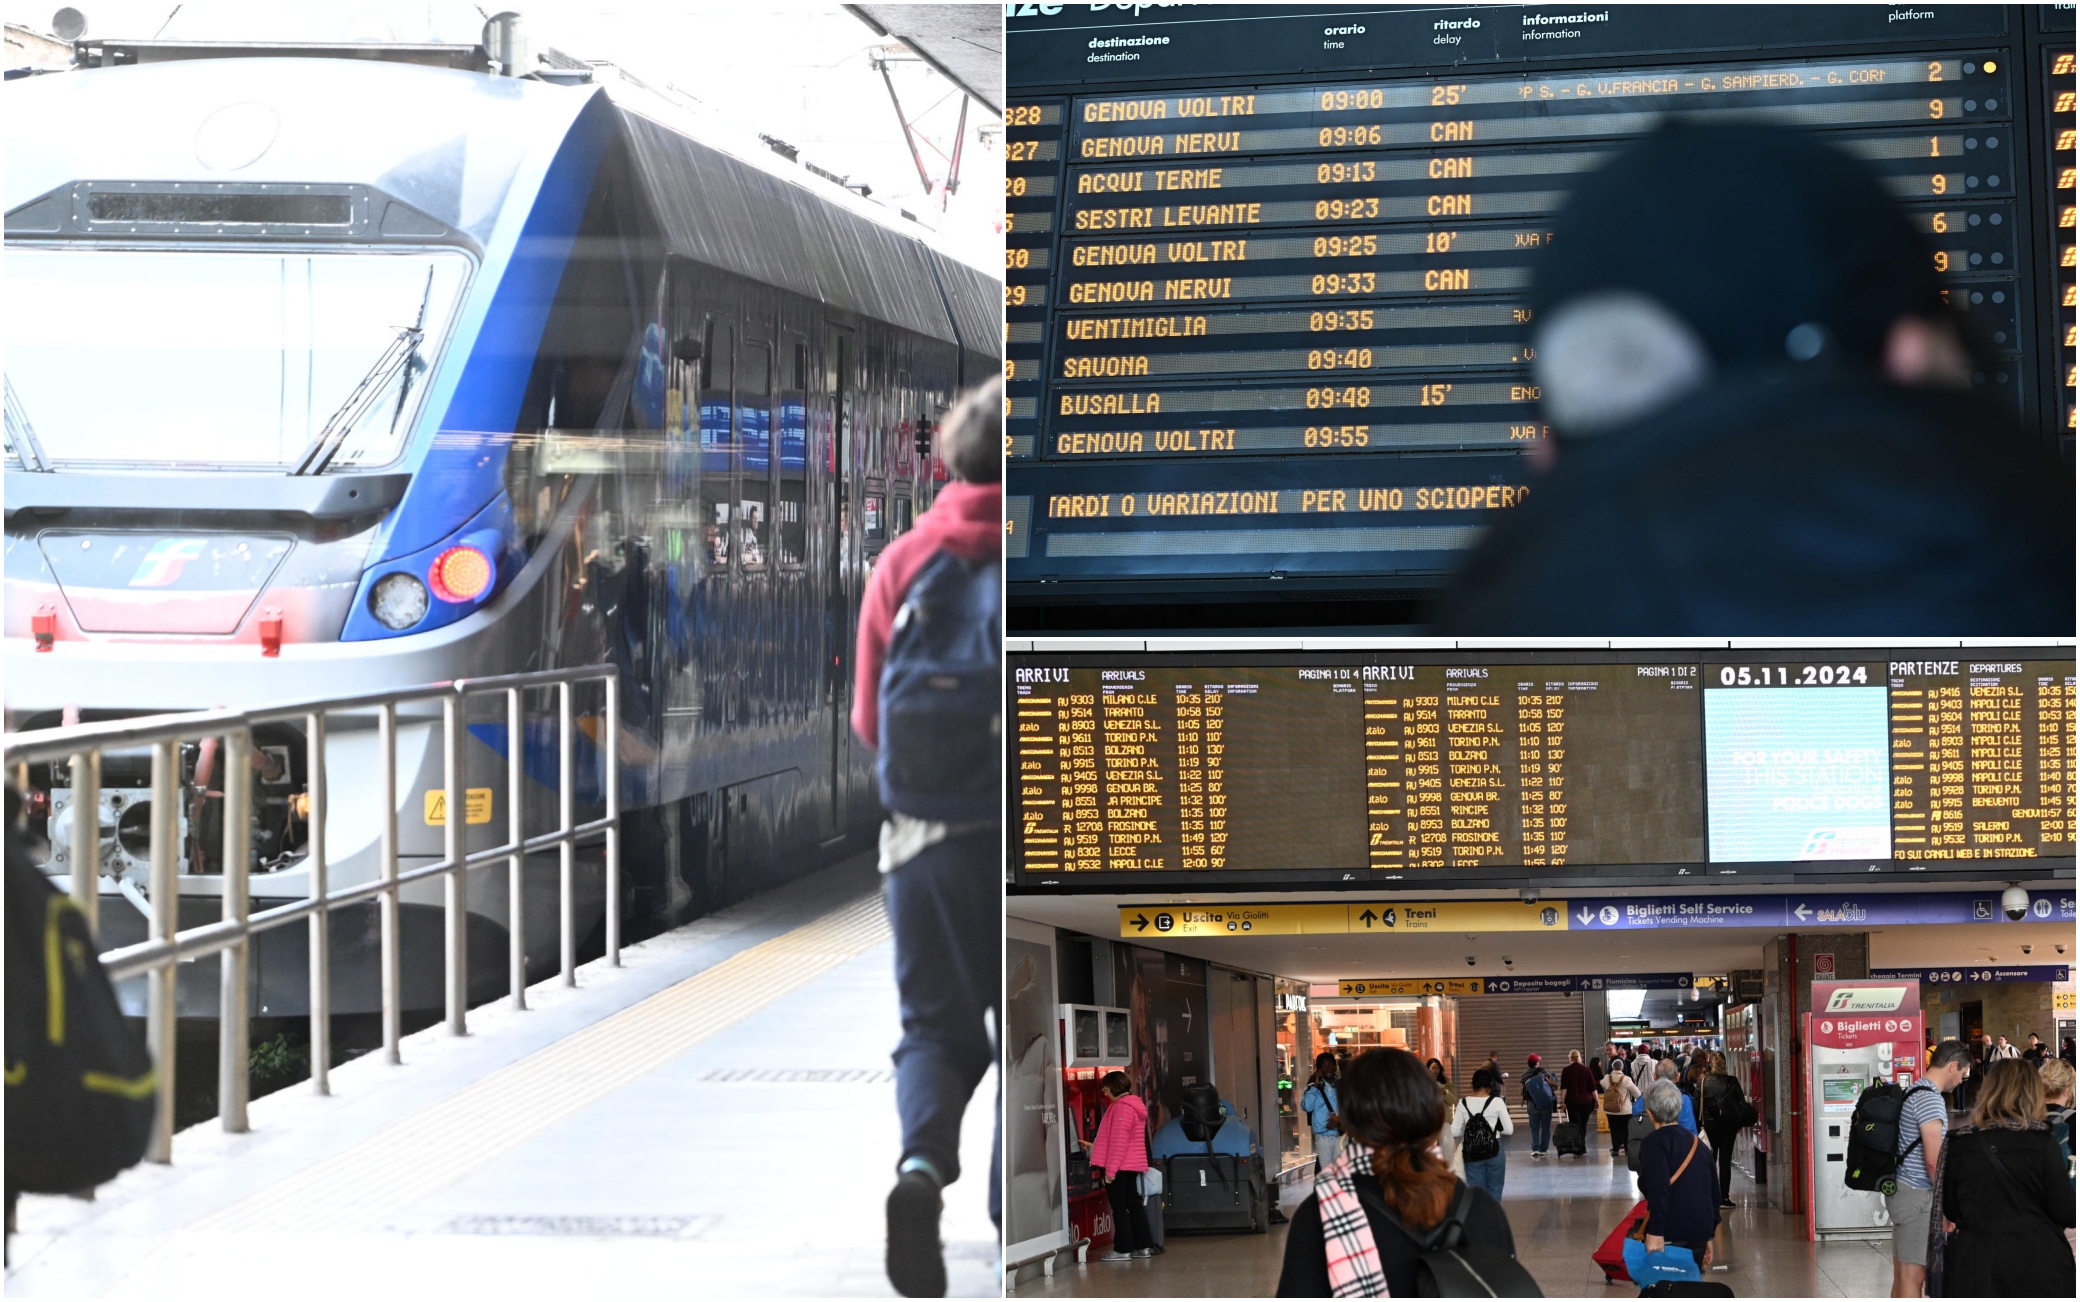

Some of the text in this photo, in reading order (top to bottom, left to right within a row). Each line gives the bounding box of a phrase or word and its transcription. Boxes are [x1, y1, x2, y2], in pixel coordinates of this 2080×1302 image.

[1522, 11, 1609, 26] informazioni
[1888, 8, 1935, 23] platform
[1324, 24, 1366, 36] orario
[1434, 18, 1481, 30] ritardo
[1088, 34, 1171, 47] destinazione
[1433, 34, 1461, 46] delay
[1522, 29, 1581, 41] information
[1323, 40, 1345, 50] time
[1087, 51, 1140, 63] destination
[1085, 100, 1166, 122] GENOVA
[1178, 95, 1255, 117] VOLTRI
[1321, 89, 1384, 111] 09:00
[1431, 85, 1466, 106] 25'
[1576, 84, 1592, 96] G.
[1700, 77, 1716, 91] G.
[1721, 73, 1804, 90] SAMPIERD.
[1827, 71, 1844, 84] G.
[1928, 61, 1942, 82] 2
[1082, 99, 1944, 158] GENOVA NERVI 09:06 CAN 9
[1078, 137, 1940, 193] ACQUI TERME 09:13 CAN 1
[1076, 174, 1947, 229] SESTRI LEVANTE 09:23 CAN 9
[1073, 212, 1948, 266] GENOVA VOLTRI 09:25 10' 6
[1069, 251, 1949, 303] GENOVA NERVI 09:33 CAN 9
[1066, 310, 1374, 340] VENTIMIGLIA 09:35
[1064, 349, 1372, 378] SAVONA 09:40
[1061, 384, 1452, 415] BUSALLA 09:48 15'
[1058, 426, 1369, 454] GENOVA VOLTRI 09:55
[1121, 495, 1135, 516] O
[1147, 492, 1278, 515] VARIAZIONI
[1302, 490, 1346, 512] PER
[1359, 488, 1403, 511] UNO
[1299, 670, 1331, 679] PAGINA
[1363, 666, 1414, 680] ARRIVI
[1446, 669, 1488, 678] ARRIVALS
[1890, 662, 1958, 675] PARTENZE
[1970, 664, 2022, 673] DEPARTURES
[1016, 668, 1069, 682] ARRIVI
[1102, 671, 1145, 680] ARRIVALS
[1721, 666, 1867, 685] 05.11.2024
[1939, 686, 2062, 698] 9416 VENEZIA 10:35
[1069, 694, 1202, 705] 9303 MILANO 10:35
[1071, 707, 1201, 717] 9514 TARANTO 10:58
[1939, 710, 2062, 722] 9604 NAPOLI 10:53
[1070, 719, 1200, 730] 8903 VENEZIA 11:05
[1072, 732, 1199, 742] 9611 TORINO 11:10
[1940, 734, 2059, 746] 8903 NAPOLI 11:15
[1071, 757, 1200, 768] 9915 TORINO 11:19
[1074, 782, 1202, 793] 9998 GENOVA 11:25
[1418, 777, 1543, 788] 9405 VENEZIA 11:22
[1941, 784, 2062, 795] 9928 TORINO 11:40
[1942, 796, 2062, 807] 9915 BENEVENTO 11:45
[1074, 807, 1204, 818] 8953 BOLZANO 11:35
[1077, 820, 1204, 832] 12708 FROSINONE 11:35
[1420, 817, 1545, 829] 8953 BOLZANO 11:35
[1942, 820, 2064, 832] 9519 SALERNO 12:00
[1422, 832, 1498, 843] 12708 FROSINONE
[1992, 847, 2037, 858] STAZIONE.
[1404, 908, 1436, 919] Treni
[1627, 903, 1753, 917] Biglietti Self Service
[1183, 911, 1269, 922] Uscita Via Giolitti
[1628, 915, 1724, 925] Tickets Vending Machine
[1183, 924, 1197, 932] Exit
[1405, 920, 1428, 928] Trains
[1545, 979, 1571, 988] bagagli
[1837, 1021, 1880, 1033] Biglietti
